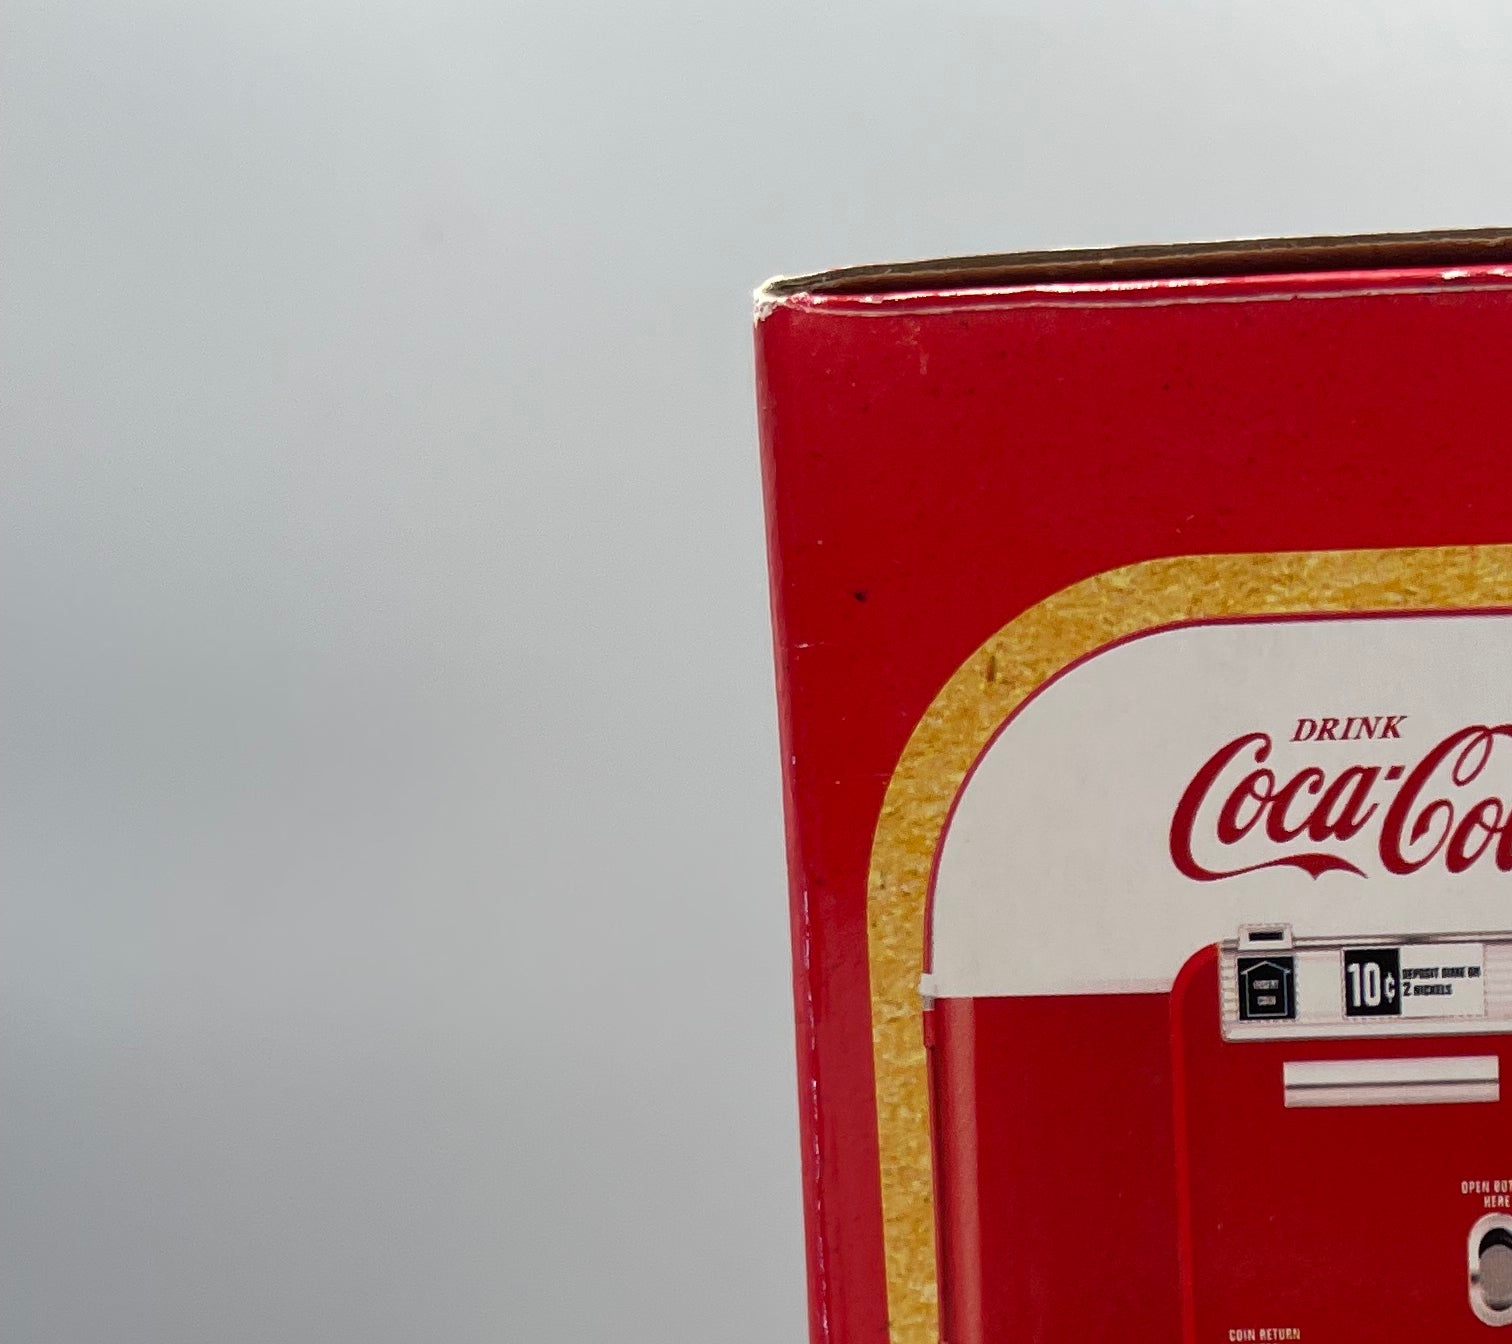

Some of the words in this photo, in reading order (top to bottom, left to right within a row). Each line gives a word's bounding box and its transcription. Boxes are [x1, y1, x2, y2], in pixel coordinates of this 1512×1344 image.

[1290, 716, 1407, 742] DRINK
[1402, 982, 1411, 996] 2
[1461, 1180, 1490, 1194] OPEN
[1483, 1195, 1511, 1208] HERE
[1229, 1329, 1256, 1342] COIN
[1259, 1328, 1301, 1341] RETURN
